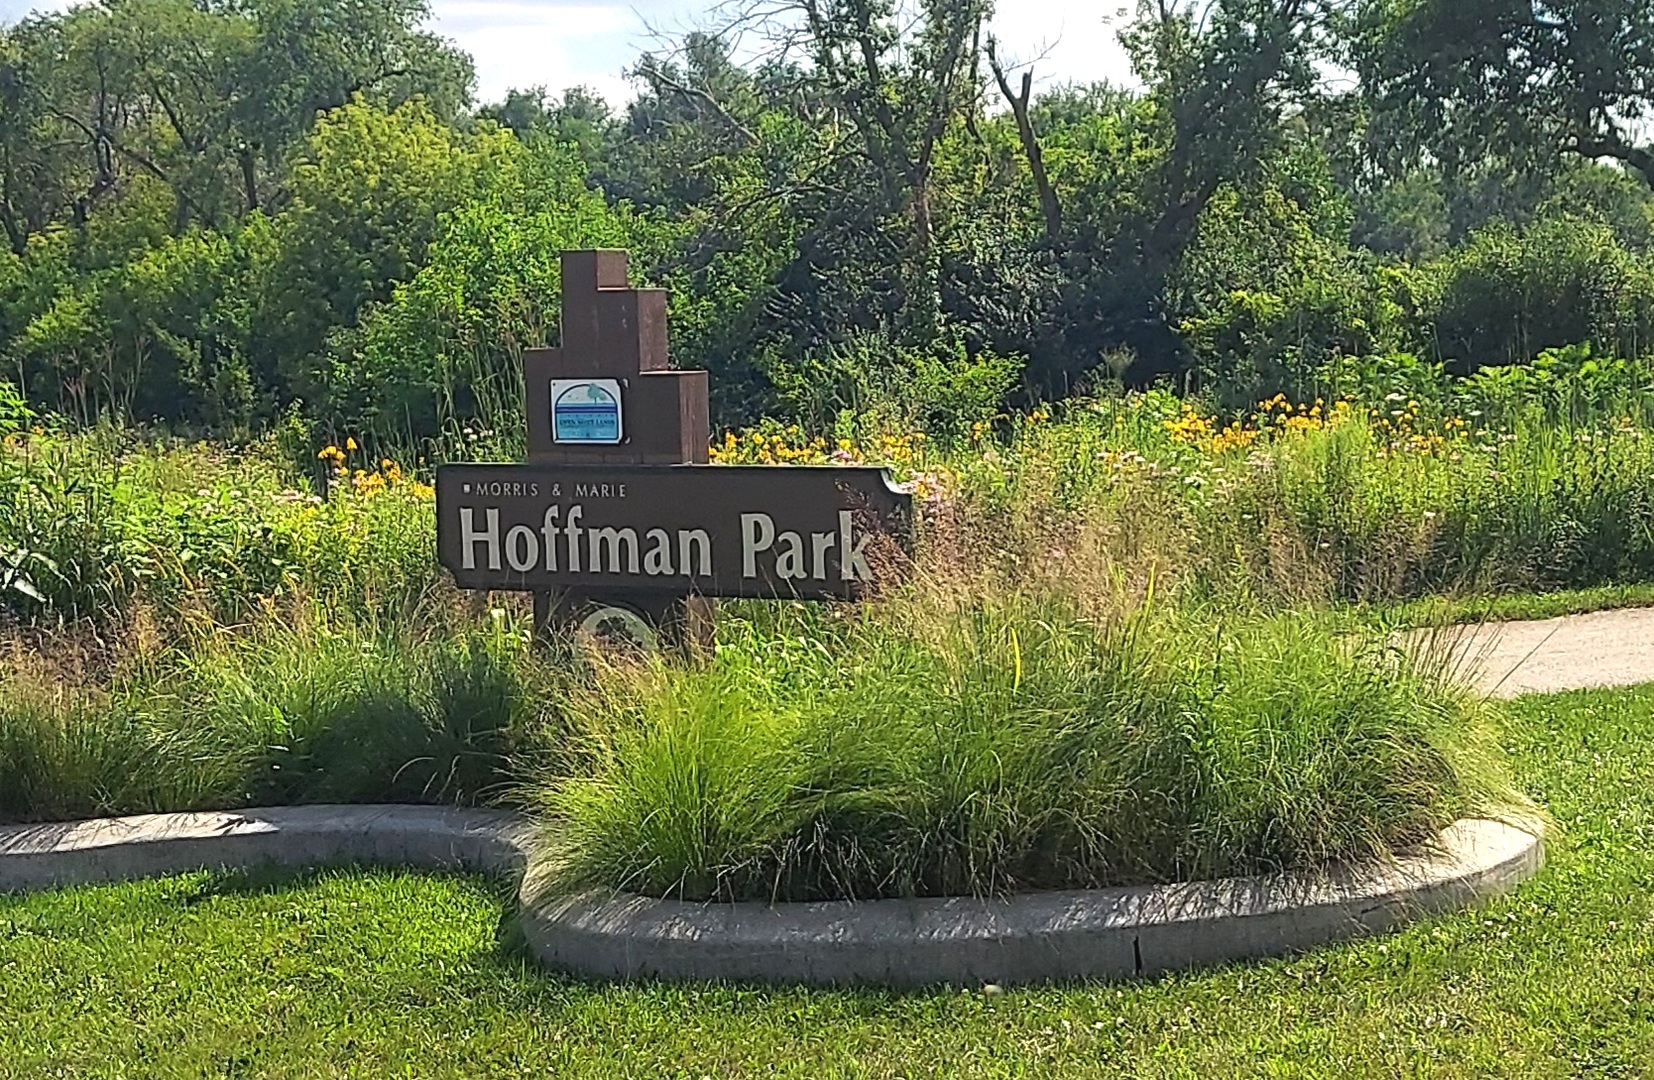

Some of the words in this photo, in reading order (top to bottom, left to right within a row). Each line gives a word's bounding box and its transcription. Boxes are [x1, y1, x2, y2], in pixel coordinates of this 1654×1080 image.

[476, 482, 539, 497] MORRIS
[552, 484, 562, 497] &
[575, 485, 627, 498] MARIE
[460, 505, 713, 576] Hoffman
[741, 511, 873, 581] Park
